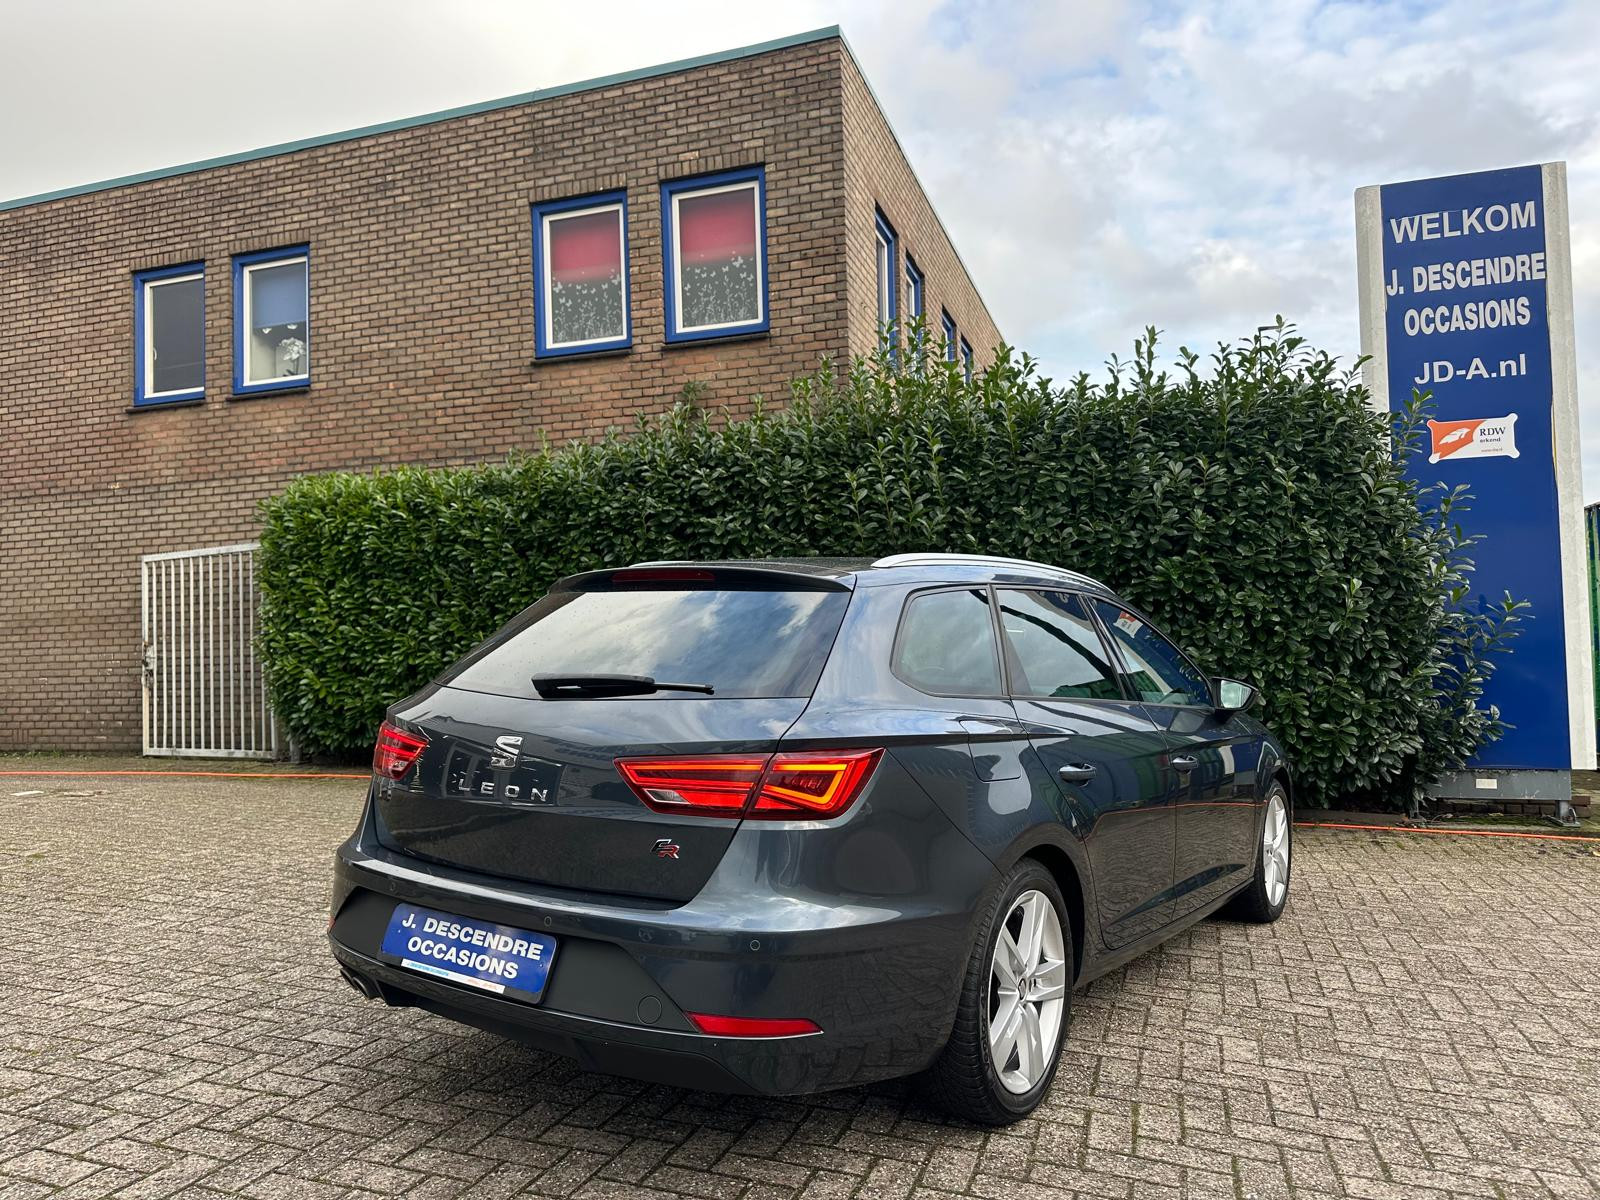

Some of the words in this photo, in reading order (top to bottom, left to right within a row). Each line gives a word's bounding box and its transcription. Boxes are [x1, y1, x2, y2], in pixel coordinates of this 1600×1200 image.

[1389, 200, 1536, 243] WELKOM
[1386, 268, 1404, 296] J.
[1412, 251, 1547, 293] DESCENDRE
[1404, 296, 1531, 336] OCCASIONS
[1414, 353, 1527, 385] JD-A.nl
[1479, 426, 1506, 436] RDW
[458, 778, 549, 802] LEON
[402, 913, 417, 929] J.
[422, 917, 544, 961] DESCENDRE
[407, 936, 519, 979] OCCASIONS
